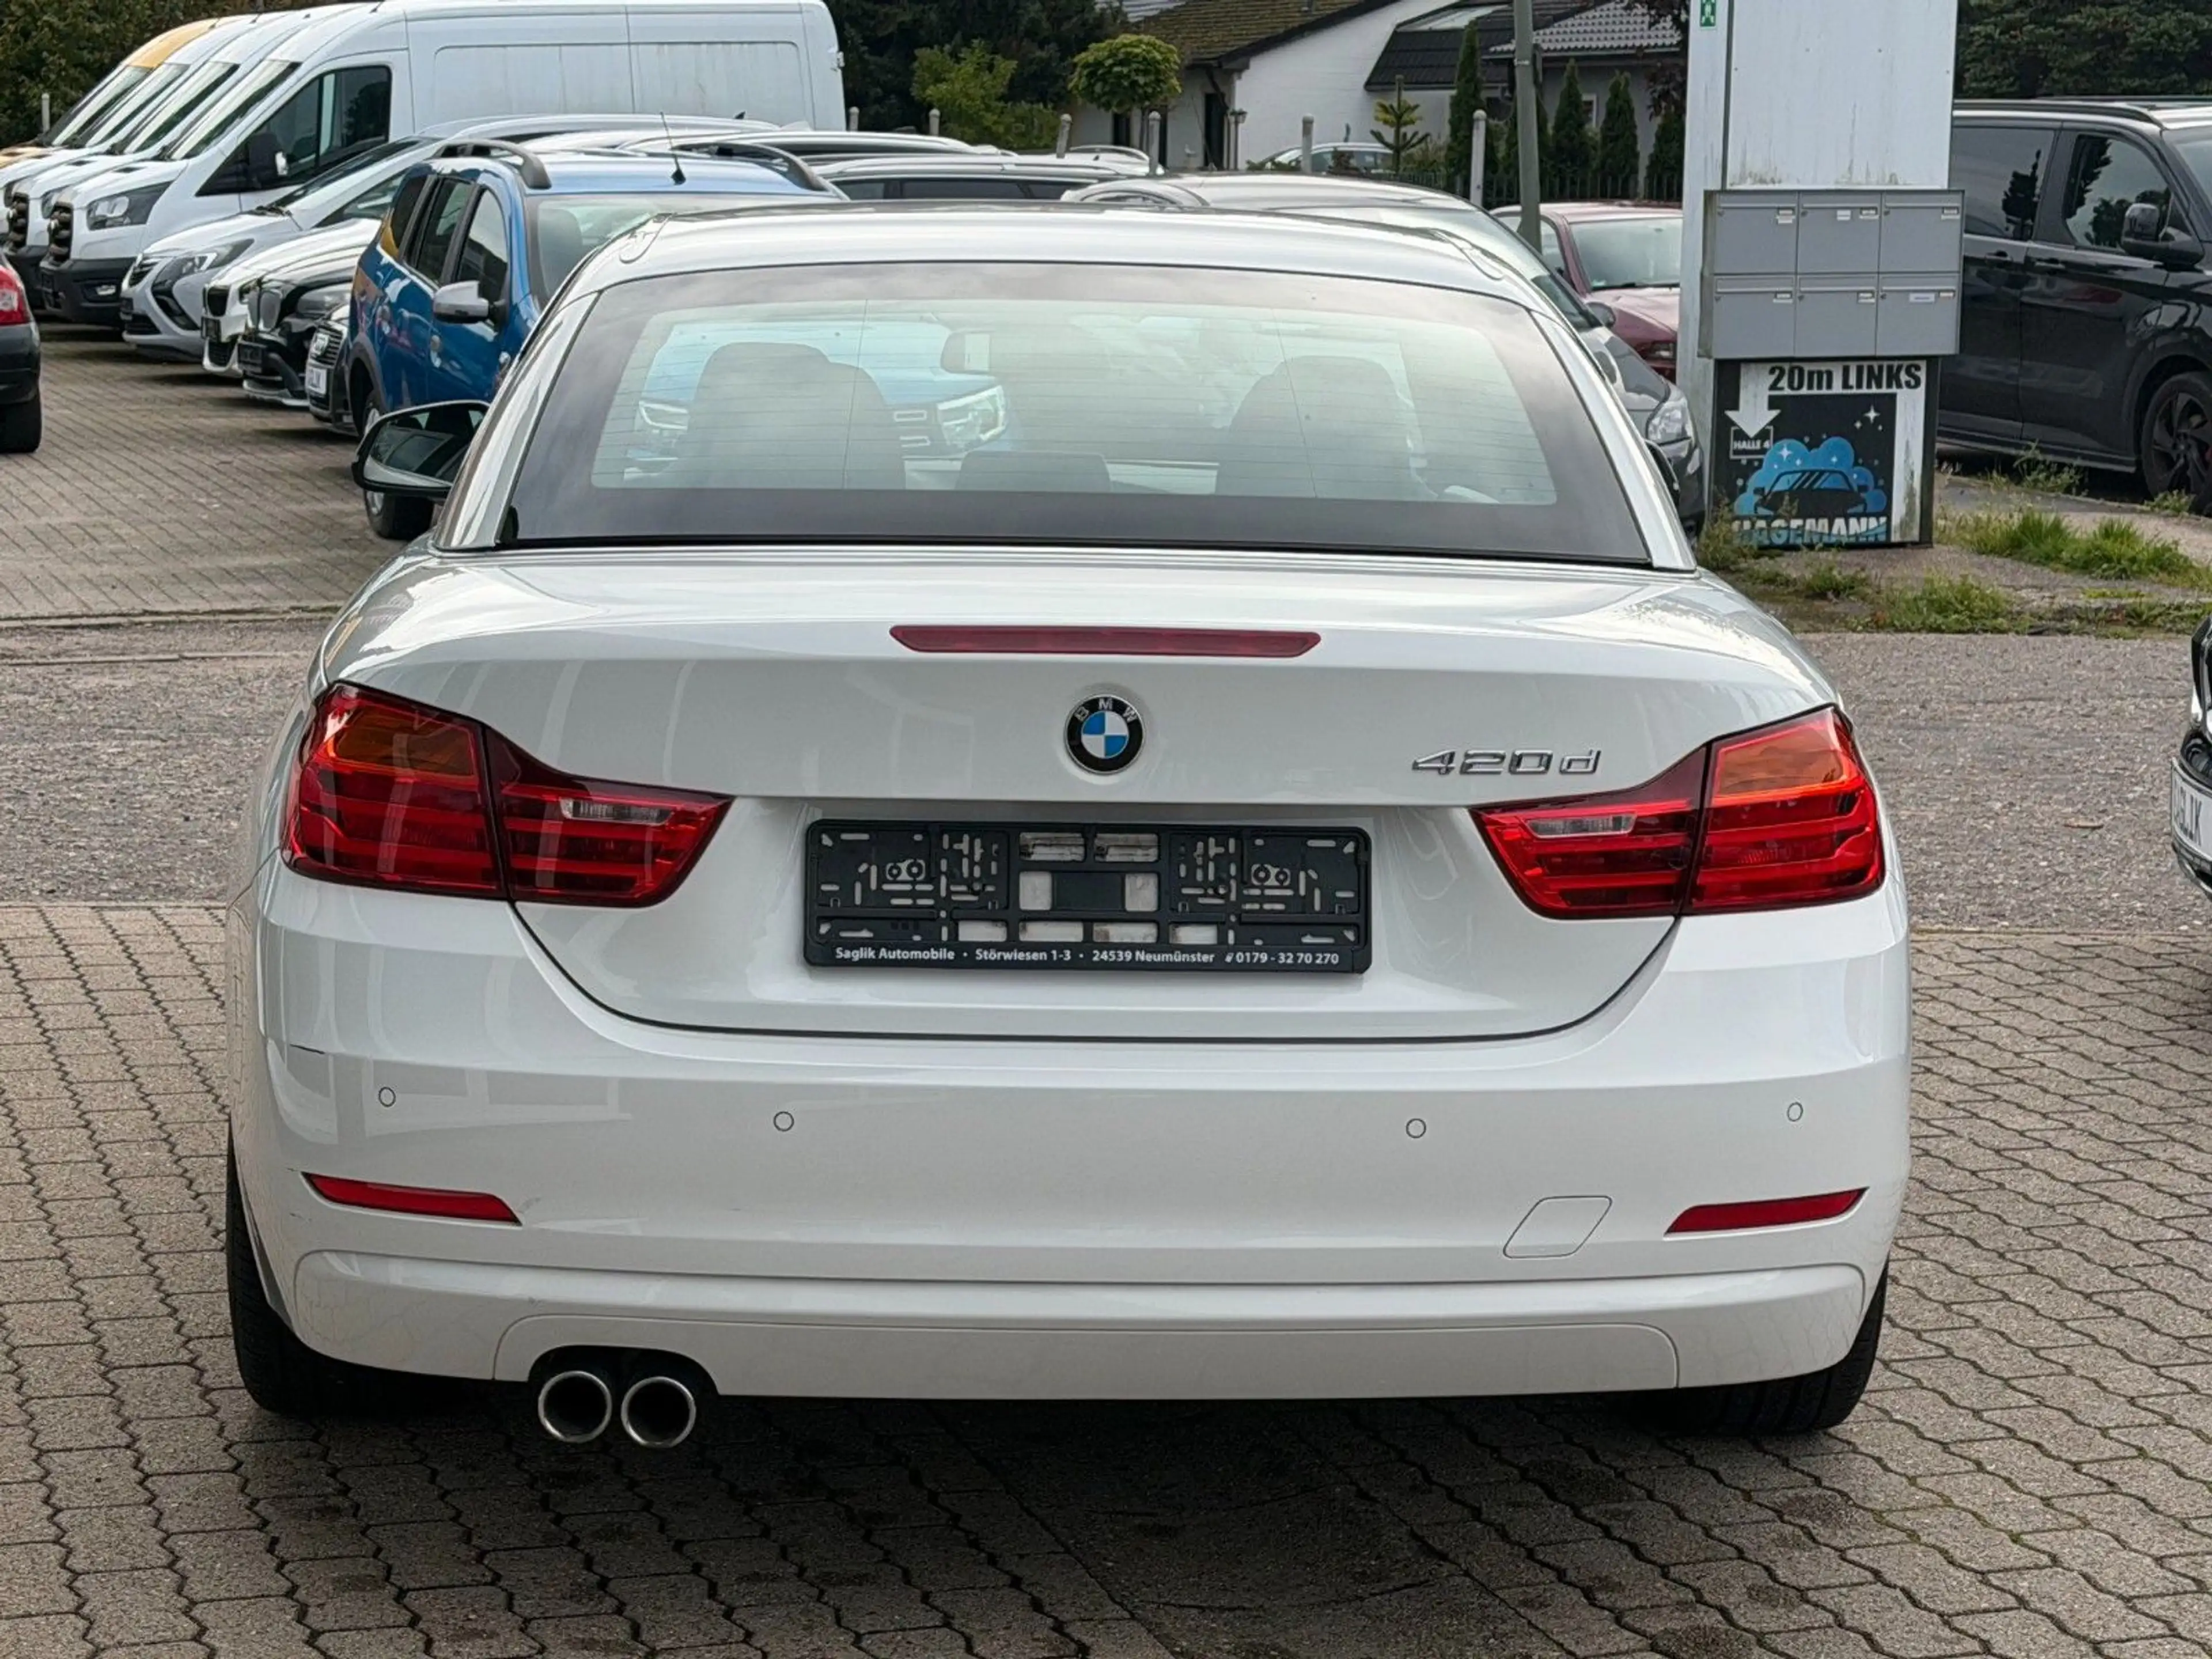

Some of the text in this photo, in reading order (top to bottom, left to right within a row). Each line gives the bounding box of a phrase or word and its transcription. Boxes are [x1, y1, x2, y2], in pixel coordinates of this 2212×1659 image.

[1768, 363, 1922, 391] 20m LINKS
[1733, 440, 1761, 450] HALLE
[1073, 697, 1138, 722] BMW
[1411, 749, 1601, 775] 420d
[835, 947, 876, 961] Saglik
[878, 948, 956, 960] Automobile
[975, 949, 1047, 961] Störwiesen
[1051, 950, 1071, 961] 1-3
[1092, 950, 1132, 962] 24539
[1135, 950, 1215, 963] Neumünster
[1236, 951, 1268, 963] 0179
[1278, 952, 1294, 964] 32
[1297, 952, 1313, 964] 70
[1315, 953, 1339, 964] 270
